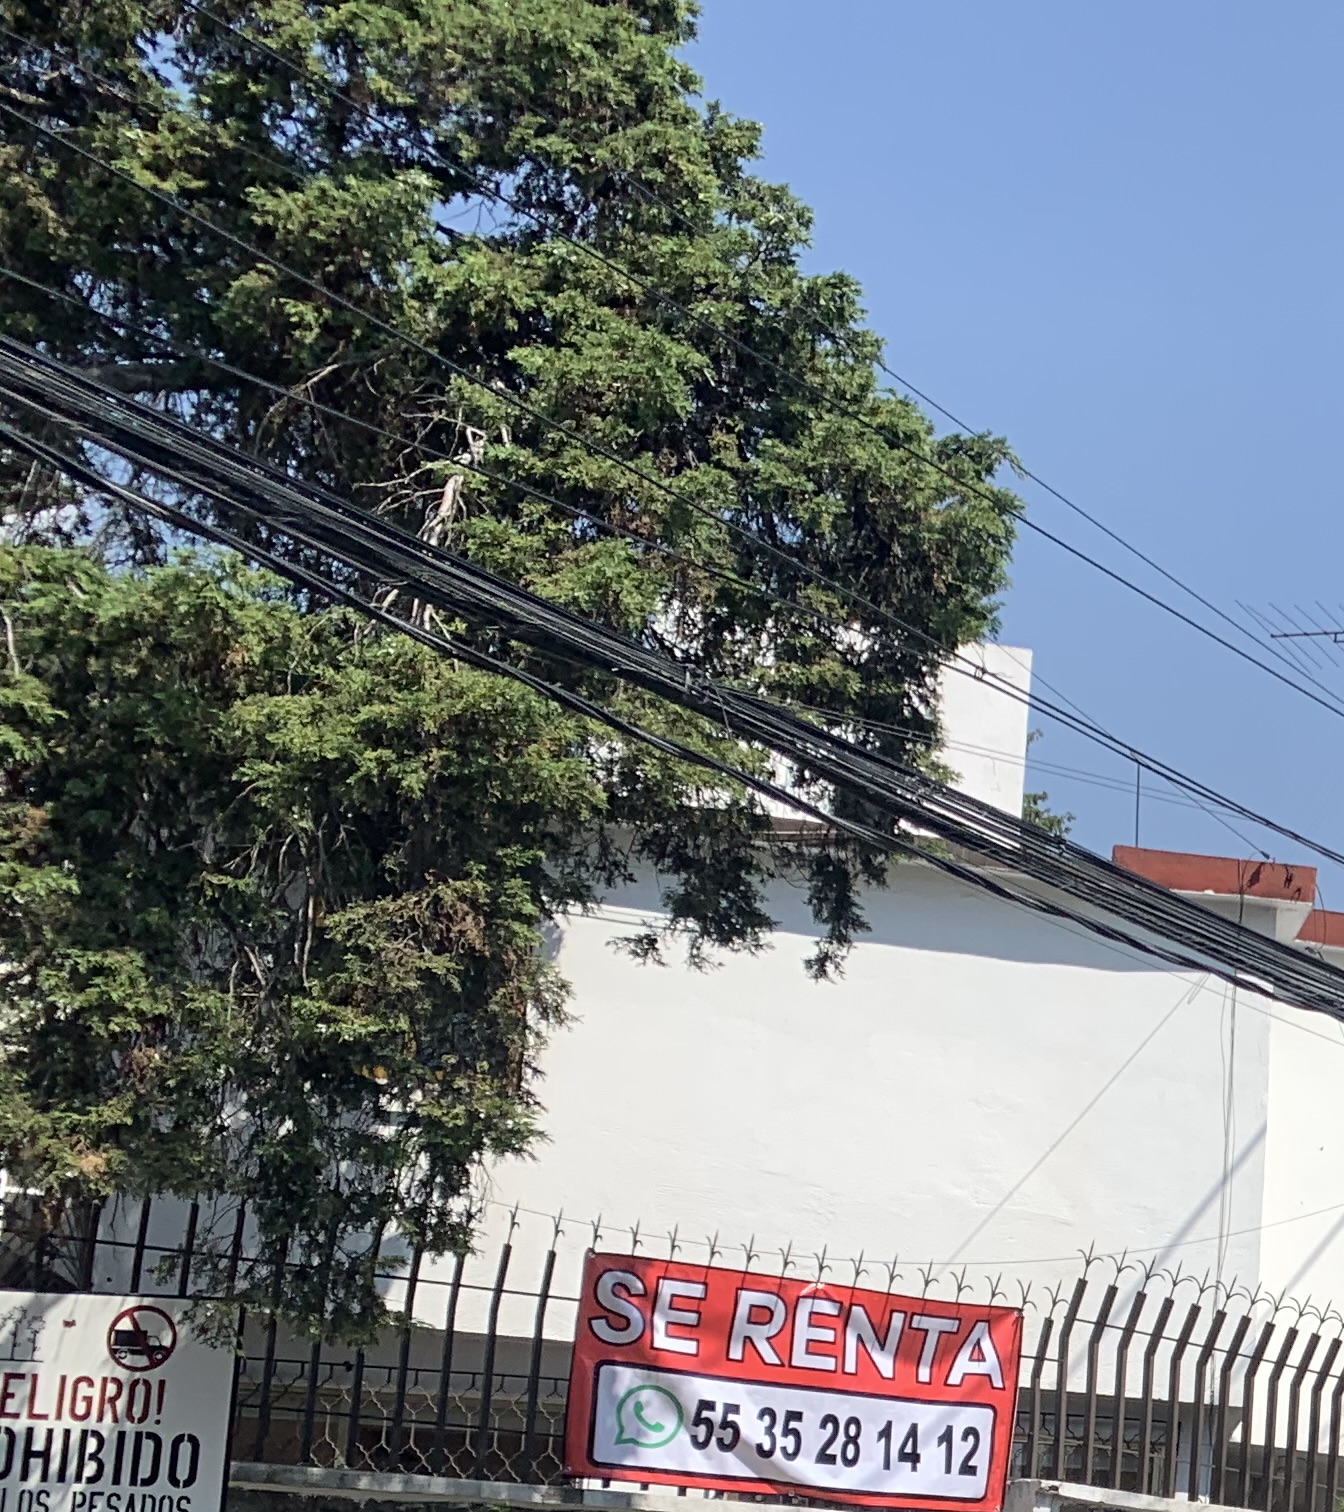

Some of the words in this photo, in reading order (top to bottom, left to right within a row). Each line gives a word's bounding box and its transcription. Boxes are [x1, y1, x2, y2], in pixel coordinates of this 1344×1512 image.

[588, 1268, 708, 1357] SE
[726, 1287, 1006, 1390] RENTA
[690, 1398, 741, 1452] 55
[755, 1406, 804, 1461] 35
[815, 1413, 863, 1468] 28
[876, 1419, 922, 1472] 14
[937, 1424, 981, 1477] 12
